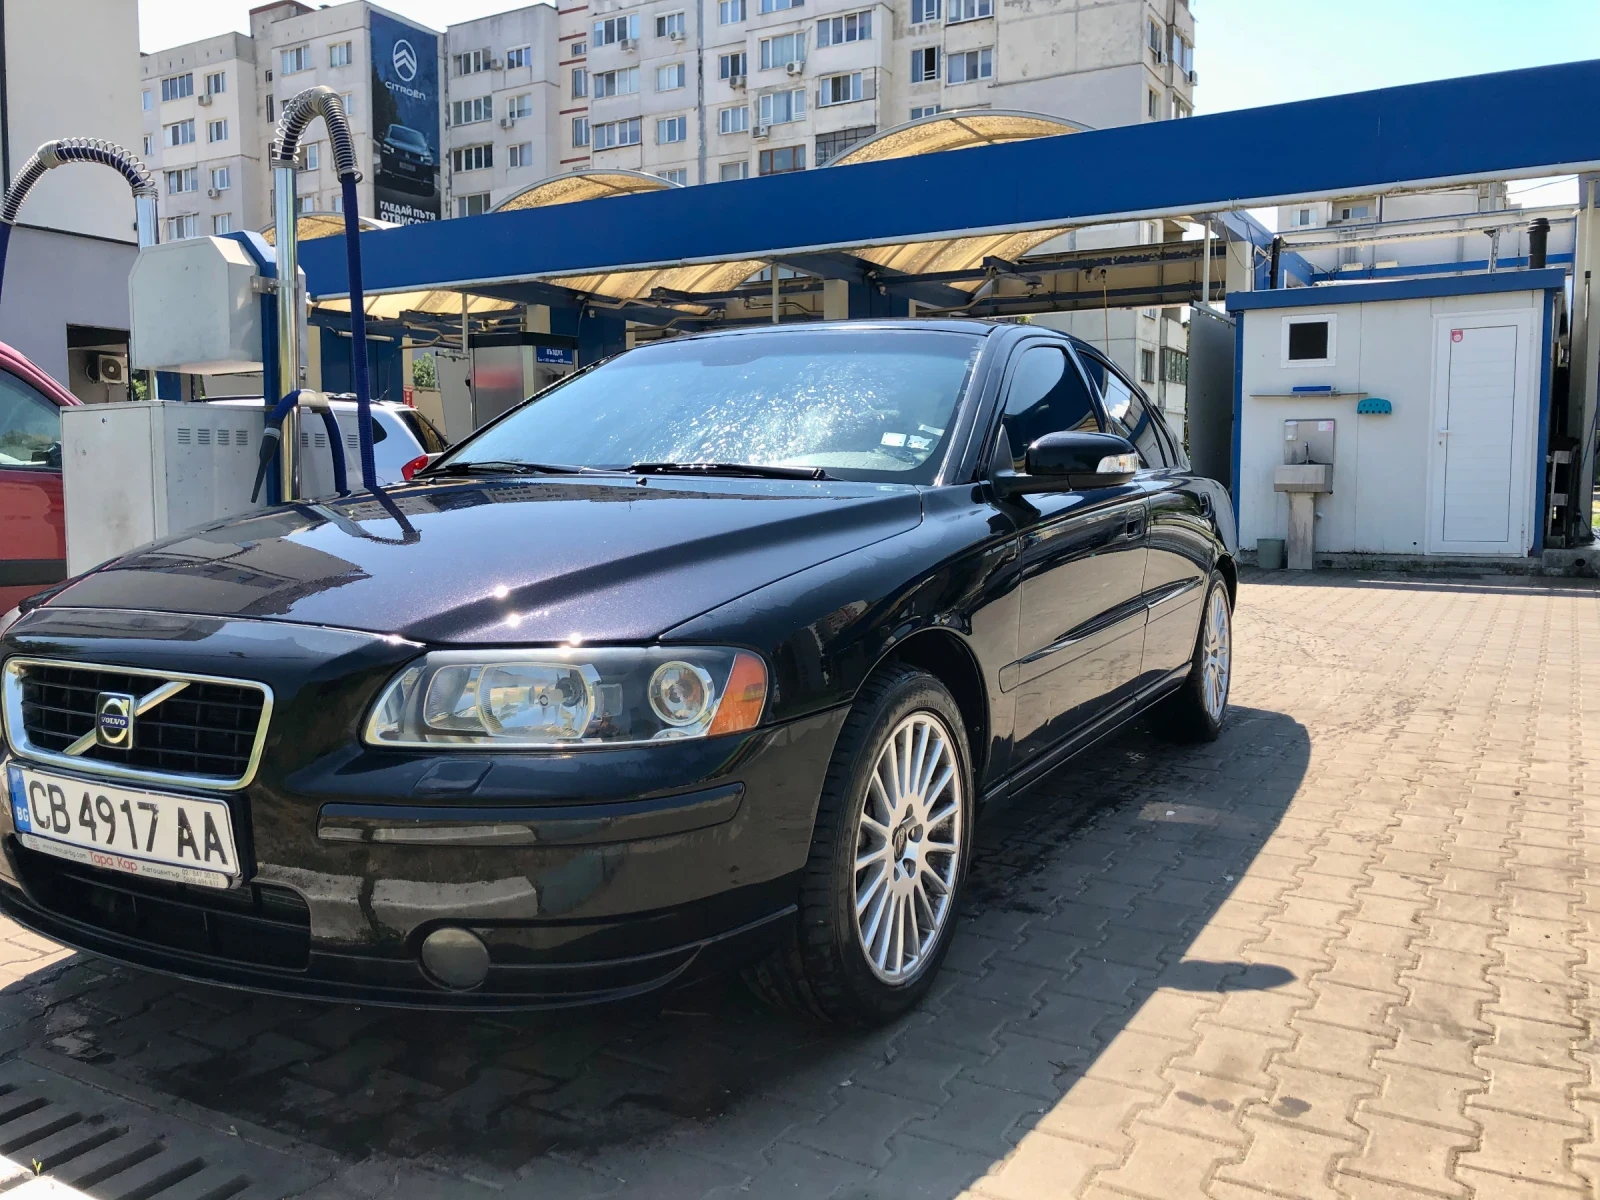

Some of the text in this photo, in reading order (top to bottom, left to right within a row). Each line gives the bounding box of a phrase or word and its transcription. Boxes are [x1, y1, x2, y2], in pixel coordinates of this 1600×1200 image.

[380, 200, 436, 221] ГЛЕДАЙ ПЪТЯ
[381, 211, 429, 226] ОТВИСО
[101, 716, 126, 726] VOLVO
[16, 806, 28, 822] BG
[29, 780, 229, 866] CB 4917 AA
[142, 865, 179, 878] Автоцентър
